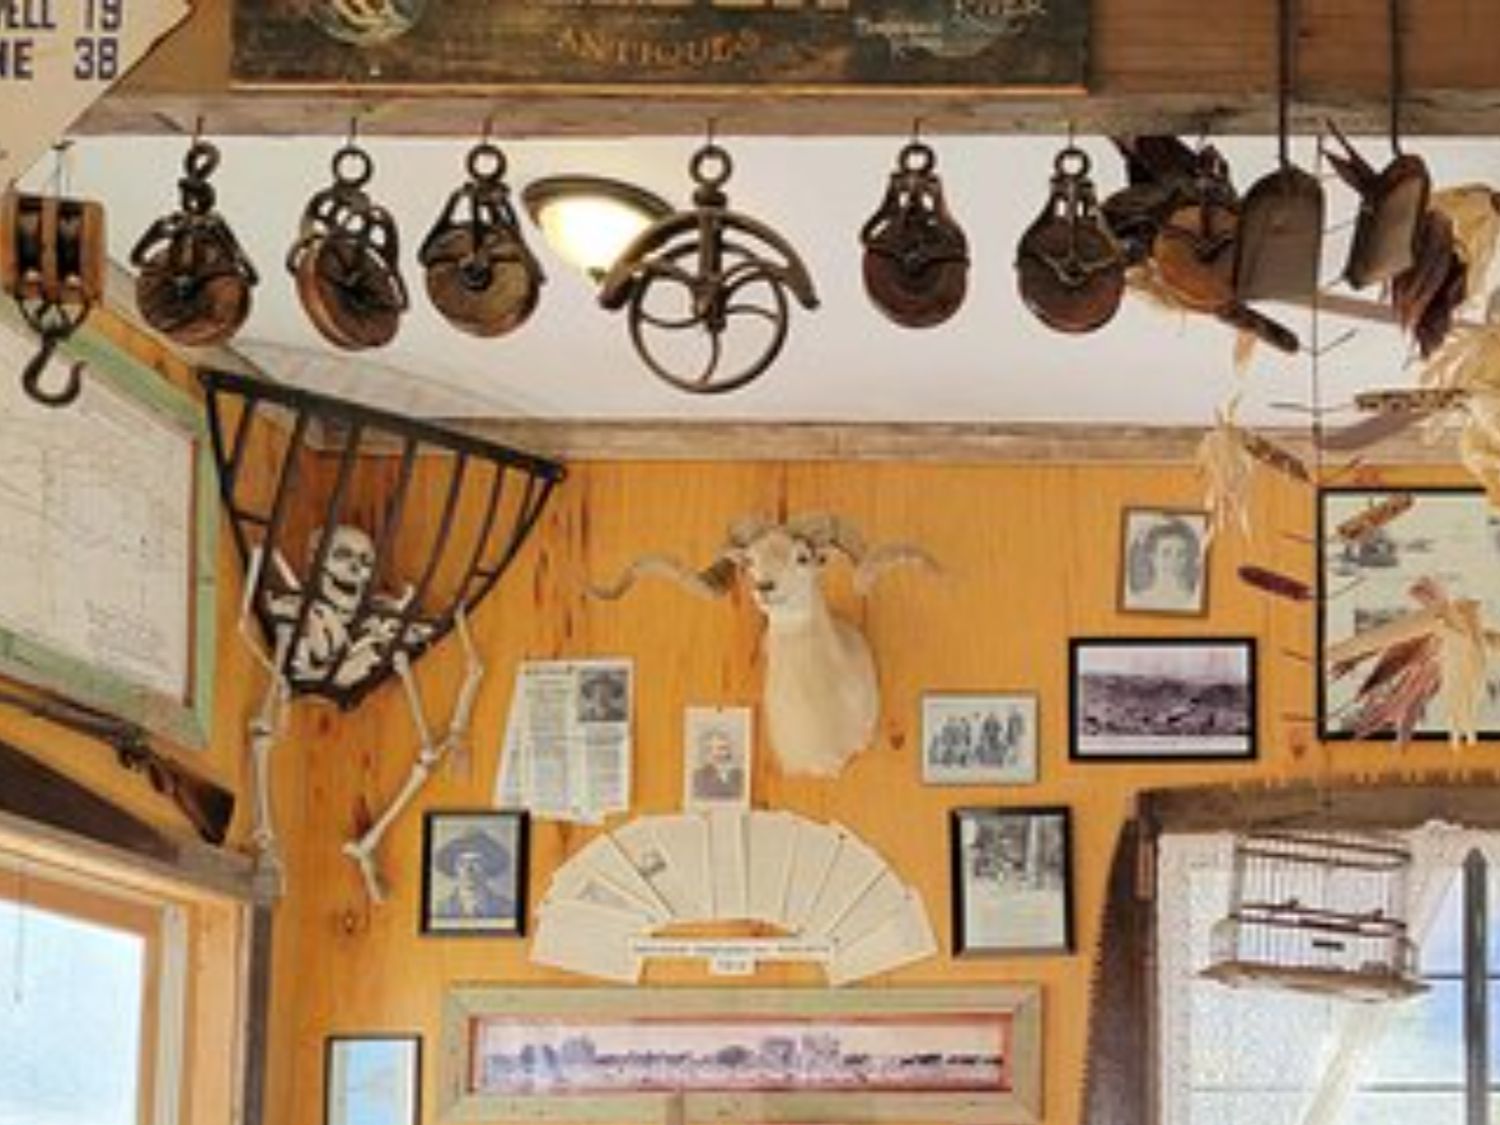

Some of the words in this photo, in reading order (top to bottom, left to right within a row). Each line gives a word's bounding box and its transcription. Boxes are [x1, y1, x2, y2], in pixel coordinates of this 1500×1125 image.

[0, 0, 56, 30] ELL
[83, 0, 122, 31] 19
[74, 37, 118, 80] 38
